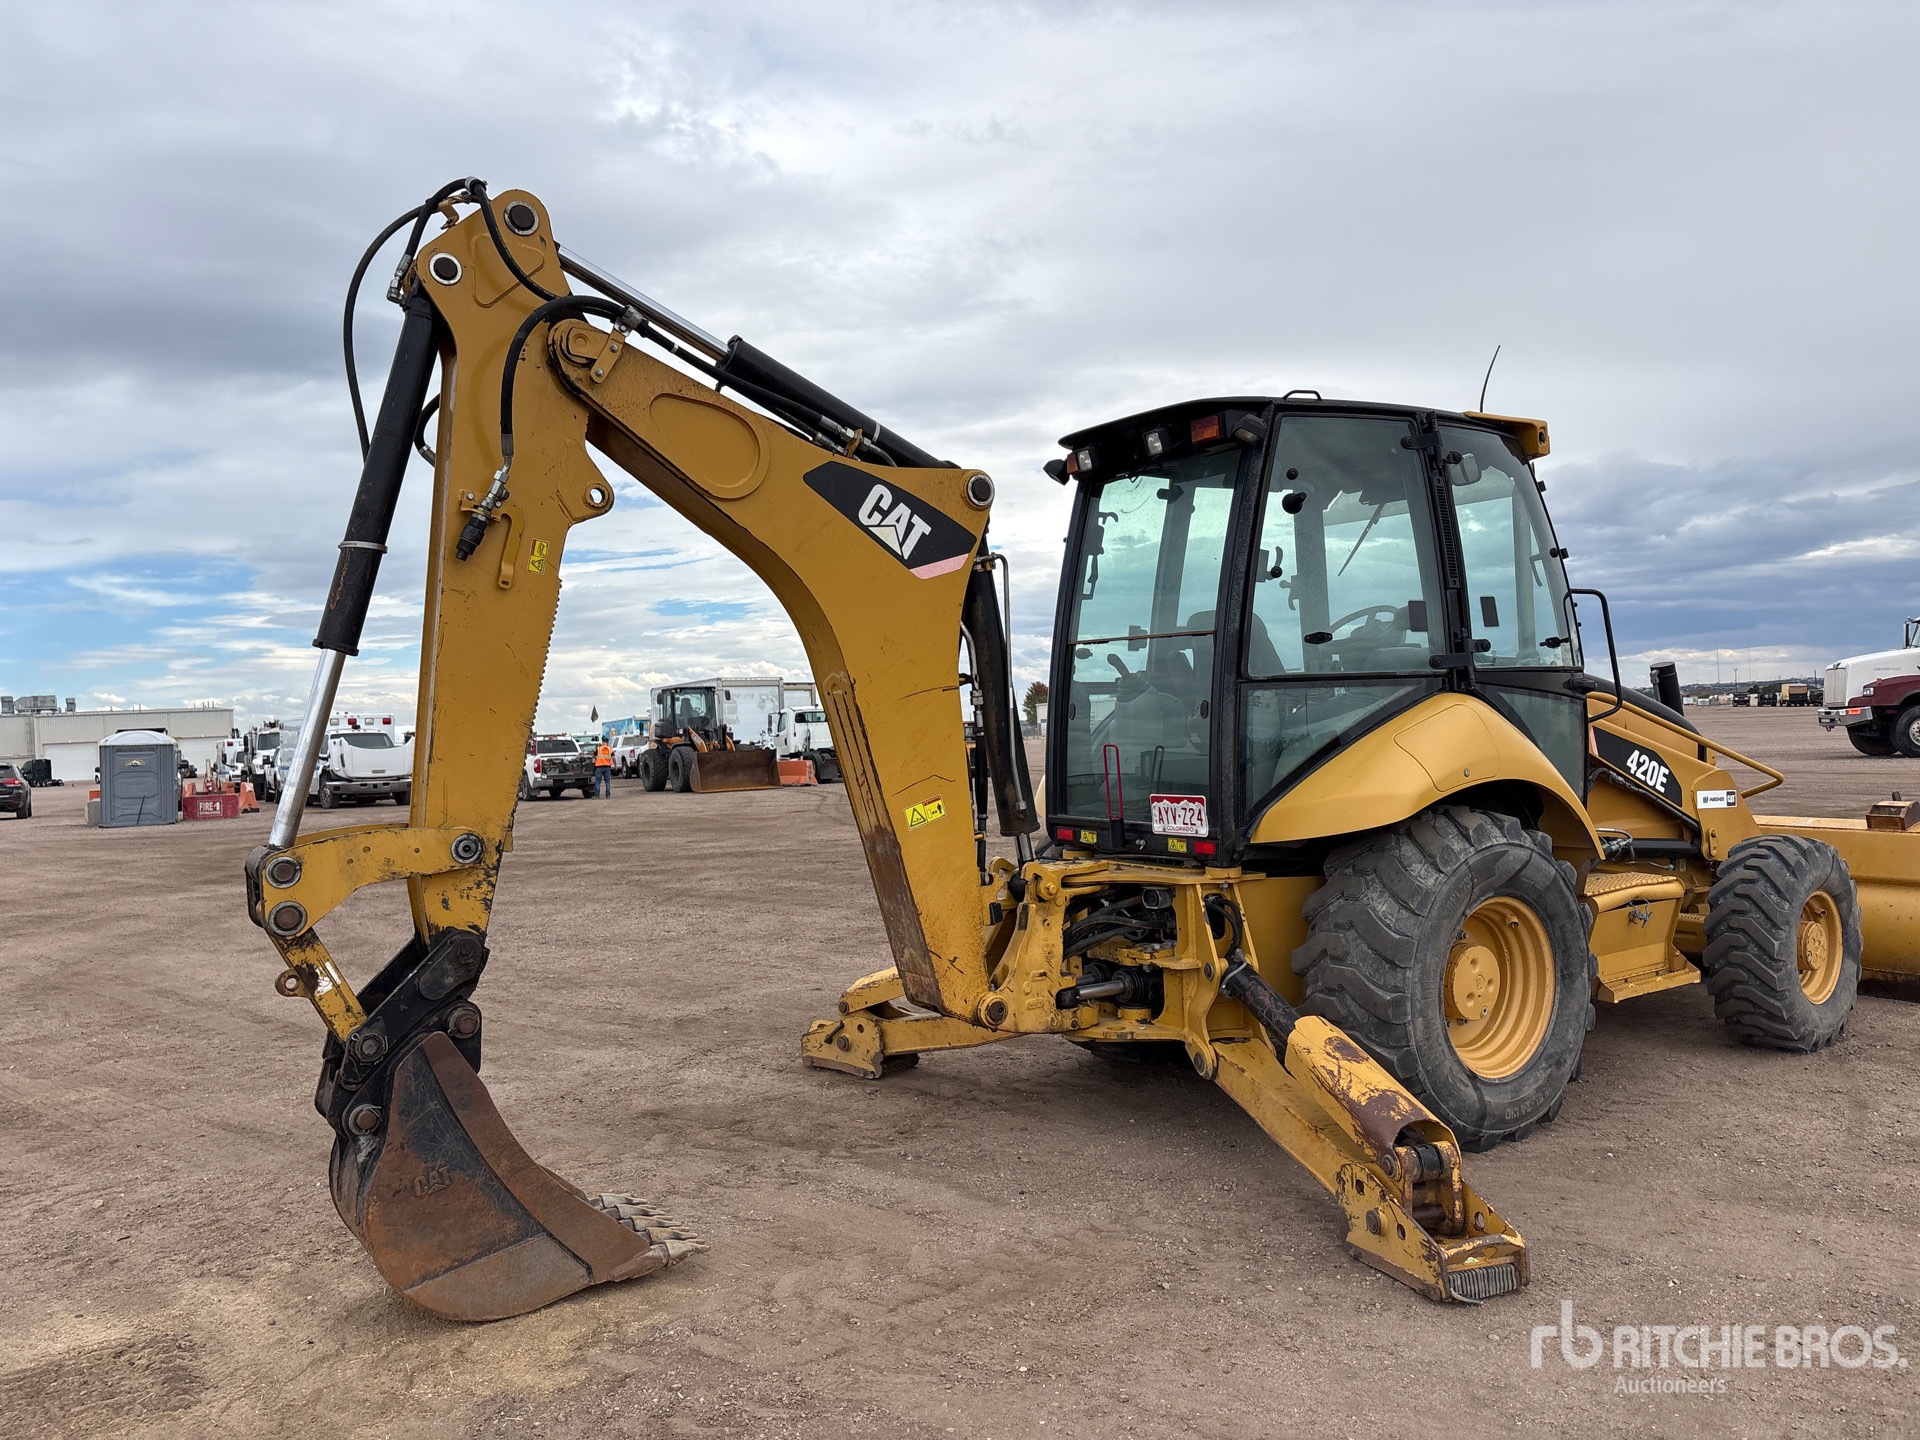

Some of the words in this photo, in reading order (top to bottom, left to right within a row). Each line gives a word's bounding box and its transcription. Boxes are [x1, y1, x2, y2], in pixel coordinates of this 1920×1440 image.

[858, 484, 932, 560] CAT
[1626, 749, 1669, 793] 420E
[1166, 825, 1195, 833] COLORADO
